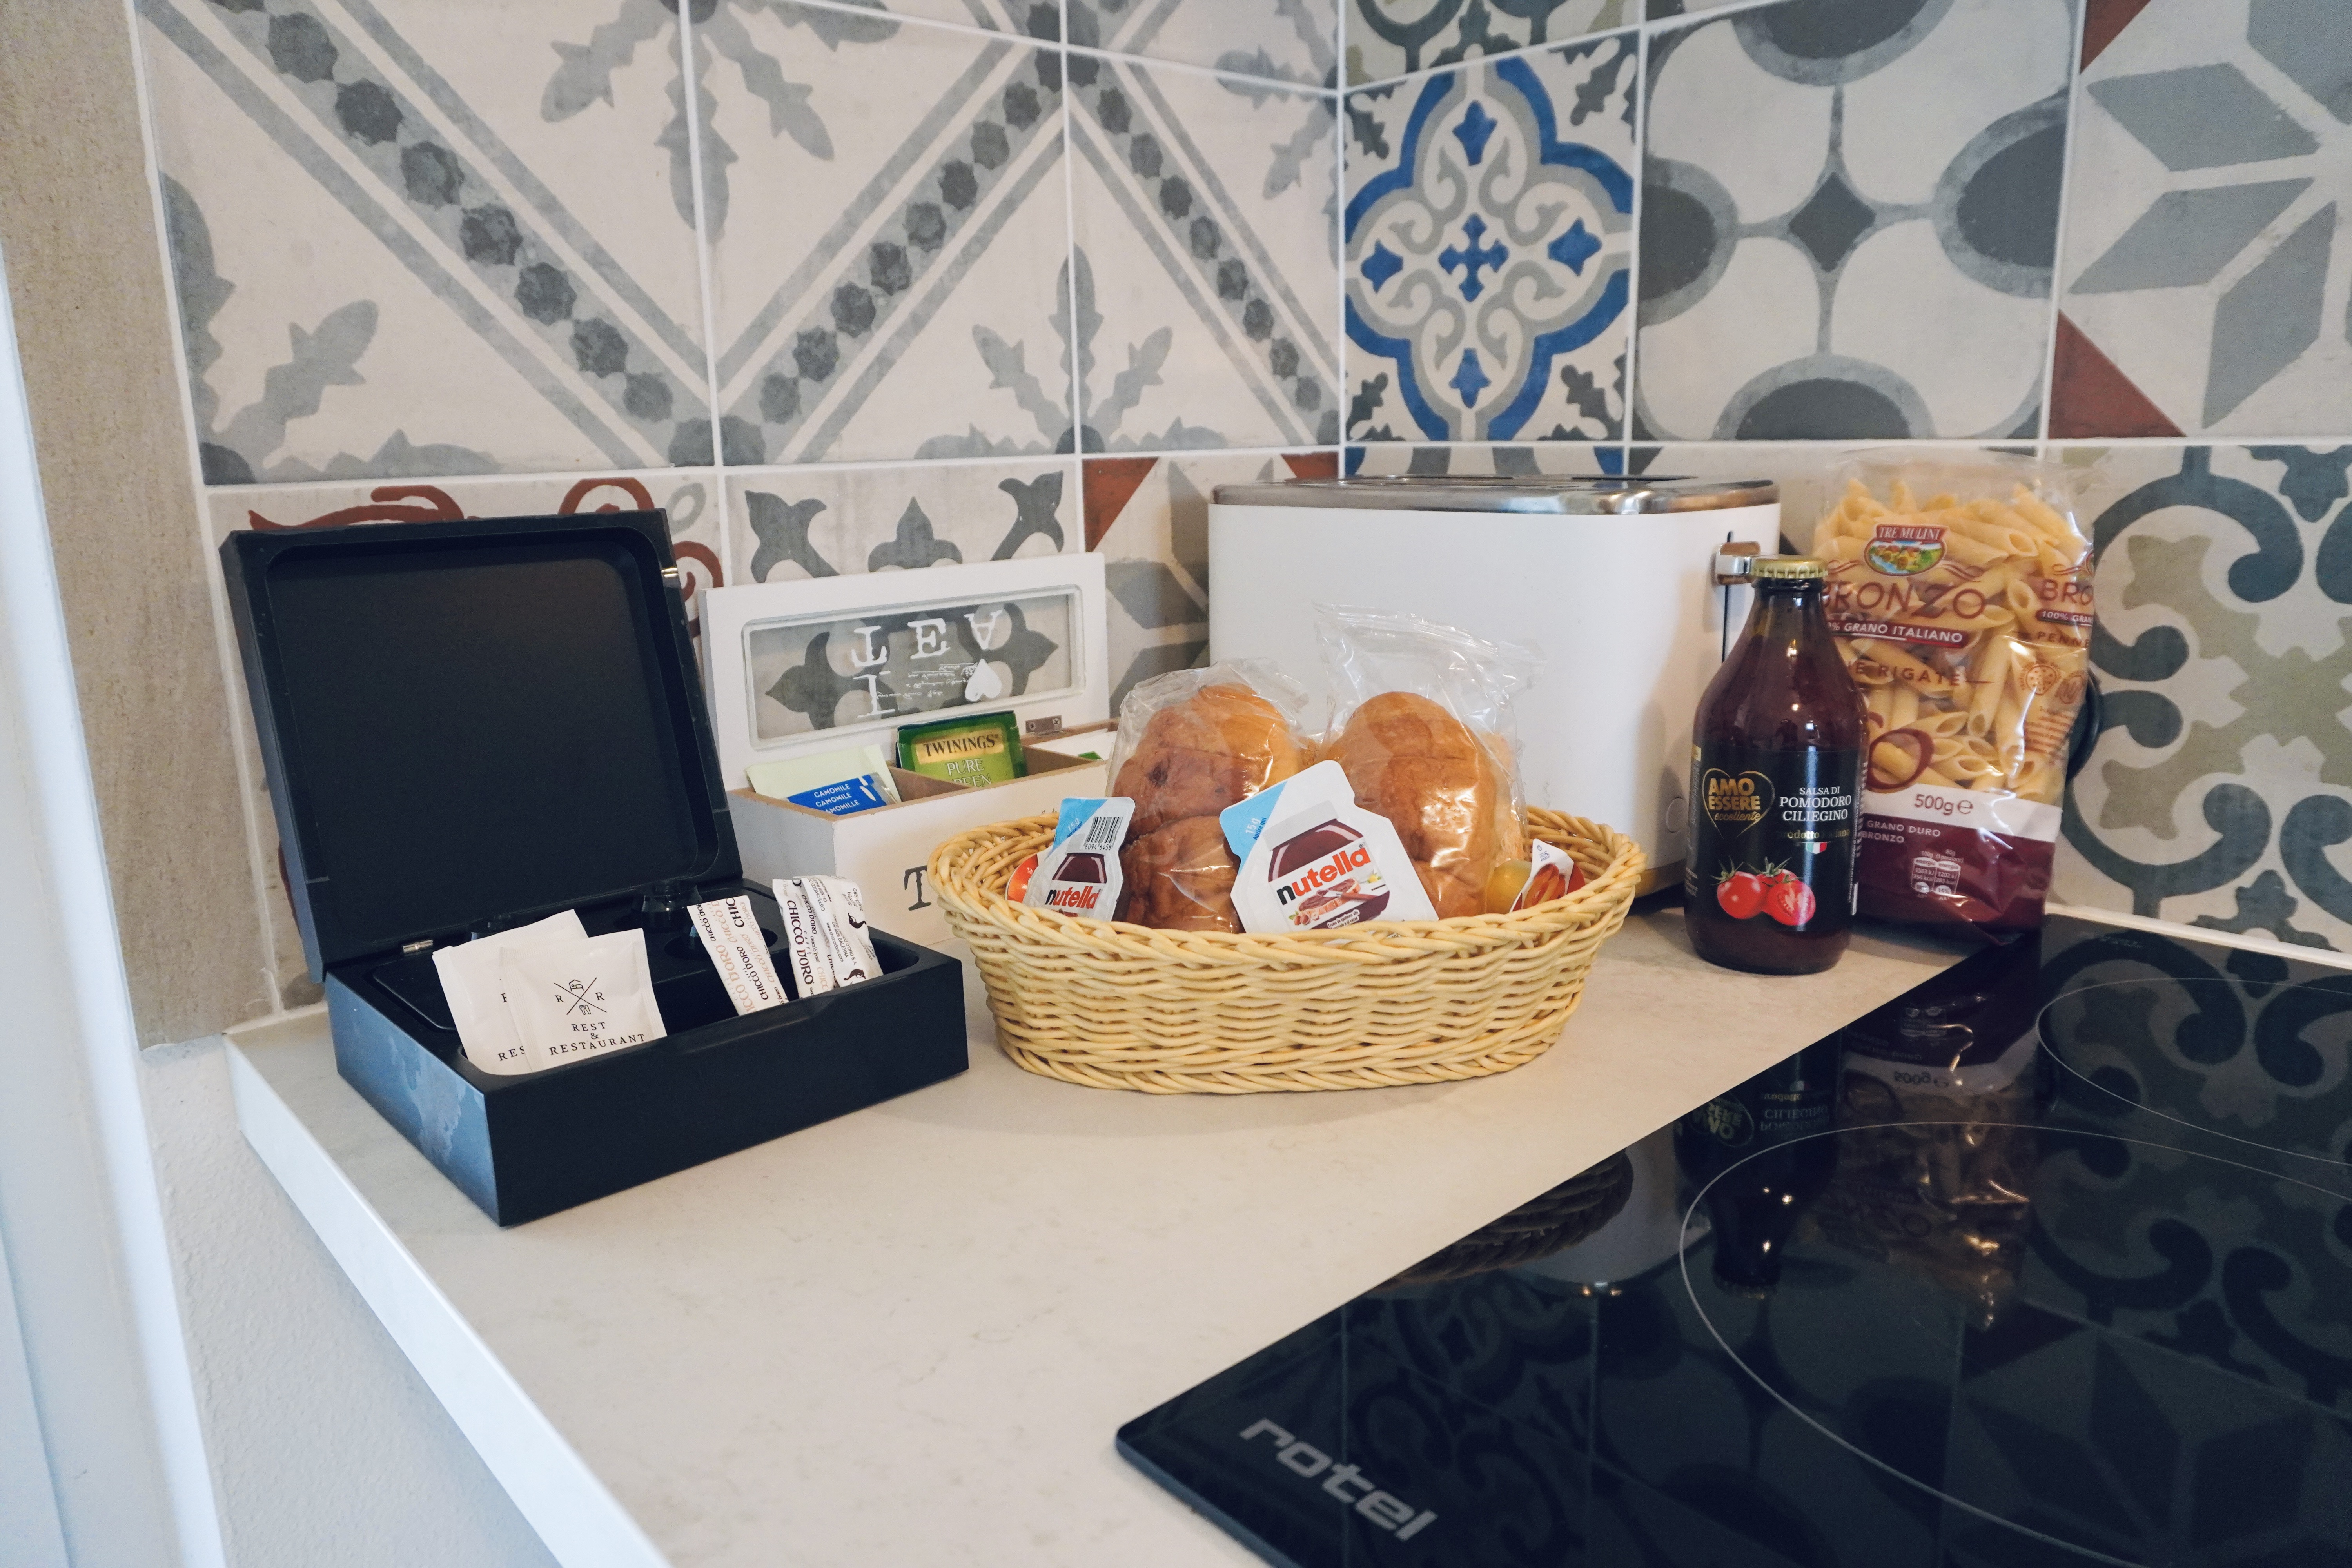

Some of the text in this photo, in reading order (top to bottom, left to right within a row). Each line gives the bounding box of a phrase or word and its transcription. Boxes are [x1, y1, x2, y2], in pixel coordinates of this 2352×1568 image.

[1880, 527, 1940, 540] TRE MULINI
[2042, 611, 2068, 620] 100%
[1844, 623, 1888, 633] GRANO
[1893, 626, 1962, 643] ITALIANO
[1878, 666, 1960, 686] RIGATE
[924, 734, 995, 757] TWININGS
[946, 758, 985, 776] PURE
[814, 783, 851, 797] CAMOMILE
[1709, 778, 1755, 796] AMO
[815, 792, 852, 807] CAMOMILE
[1709, 796, 1760, 810] ESSERE
[1779, 795, 1851, 808] POMODORO
[1915, 794, 1954, 815] 500g
[1715, 811, 1760, 820] eccellente
[1782, 809, 1848, 821] CILIEGINO
[1245, 824, 1256, 833] 15
[1253, 826, 1263, 840] Aprire
[1862, 831, 1904, 843] BRONZO
[1867, 820, 1940, 837] GRANO DURO
[1276, 847, 1371, 906] nutella
[904, 865, 933, 911] T
[801, 895, 812, 913] CHICCO
[1045, 886, 1099, 909] nutella
[702, 918, 716, 941] CHICCO
[787, 900, 804, 945] CHICCO
[797, 949, 814, 985] D'ORO
[826, 922, 844, 962] www.chiccodoro.com
[838, 937, 849, 958] BALERNA
[715, 944, 740, 982] D'ORO
[756, 955, 775, 982] CHICCO
[737, 946, 768, 1000] CHICCO D'ORO
[555, 992, 605, 1003] R R
[571, 1022, 606, 1031] REST
[549, 1034, 645, 1056] RESTAURANT
[1240, 1417, 1438, 1542] rotel
